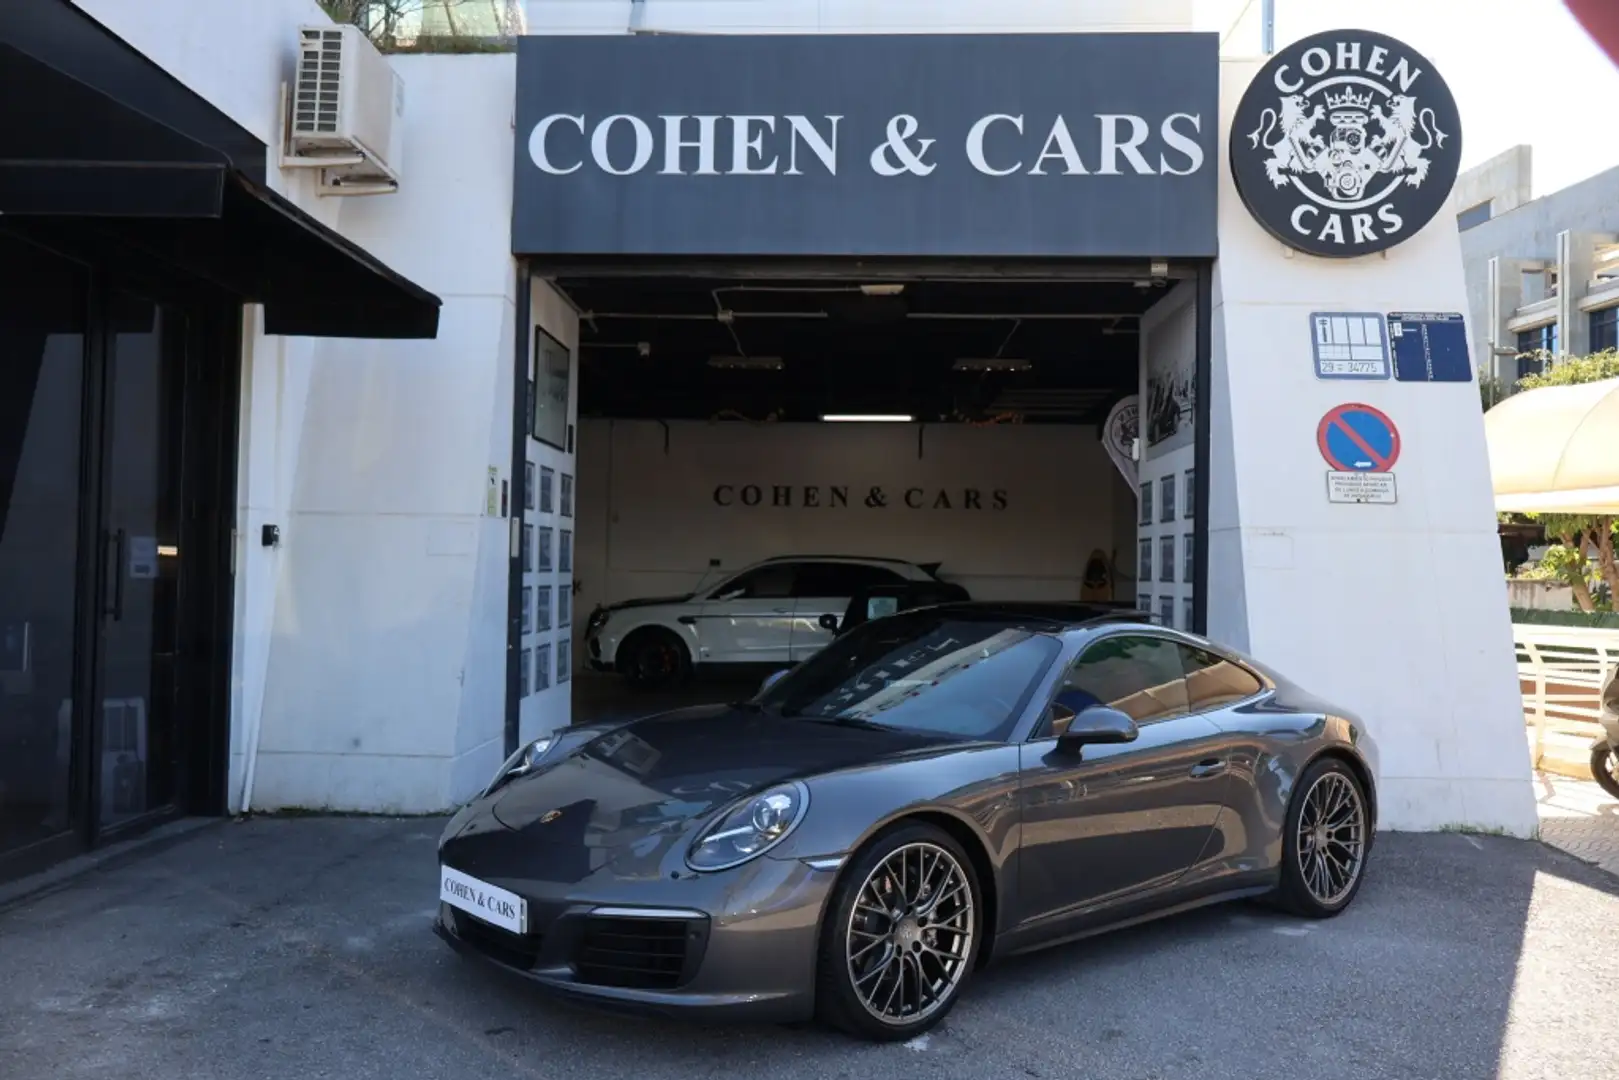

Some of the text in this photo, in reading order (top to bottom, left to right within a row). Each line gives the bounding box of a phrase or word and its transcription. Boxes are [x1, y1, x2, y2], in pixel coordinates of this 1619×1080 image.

[1274, 42, 1422, 93] COHEN
[528, 112, 1204, 176] COHEN & CARS
[1290, 203, 1403, 244] CARS
[712, 484, 1008, 511] COHEN & CARS
[444, 877, 516, 920] COHEN & CARS
